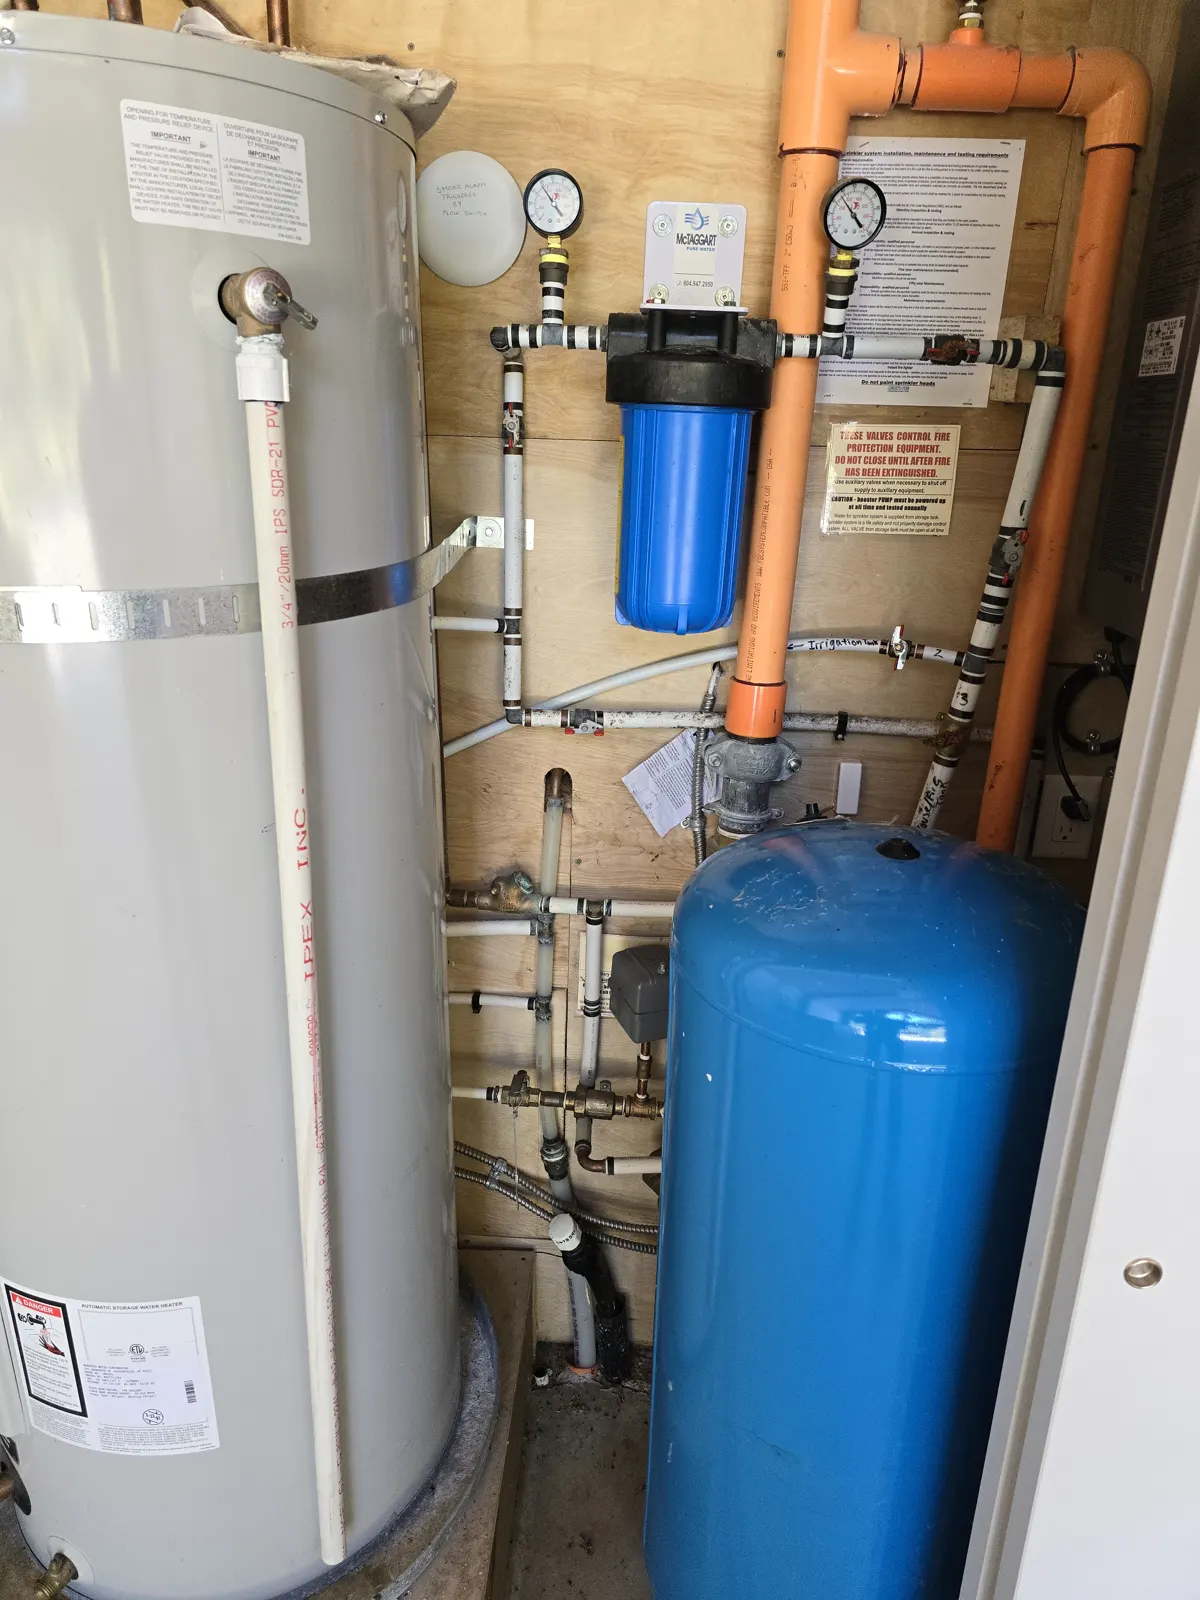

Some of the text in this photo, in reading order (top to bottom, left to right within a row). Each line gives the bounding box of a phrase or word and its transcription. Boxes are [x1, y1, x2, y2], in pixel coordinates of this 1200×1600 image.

[126, 106, 212, 125] OPENING FOR TEMPERATURE
[138, 116, 170, 126] PRESSURE
[172, 120, 192, 128] RELIEF
[224, 122, 256, 134] OUVERTURE
[150, 131, 191, 143] IMPORTANT
[248, 150, 280, 161] IMPORTANT
[866, 432, 894, 441] VALVES
[897, 432, 931, 441] CONTROL
[934, 432, 950, 442] FIRE
[846, 444, 941, 454] PROTECTION EQUIPMENT.
[835, 456, 951, 466] DO NOT CLOSE UNTIL AFTER FIRE
[268, 442, 284, 498] SDR-21
[845, 468, 938, 478] HAS BEEN EXTINGUISHED.
[273, 508, 288, 534] IPS
[808, 638, 878, 651] Irrigation Tank
[933, 649, 943, 658] 2
[300, 900, 315, 982] IPEX
[23, 1299, 54, 1314] DANGER
